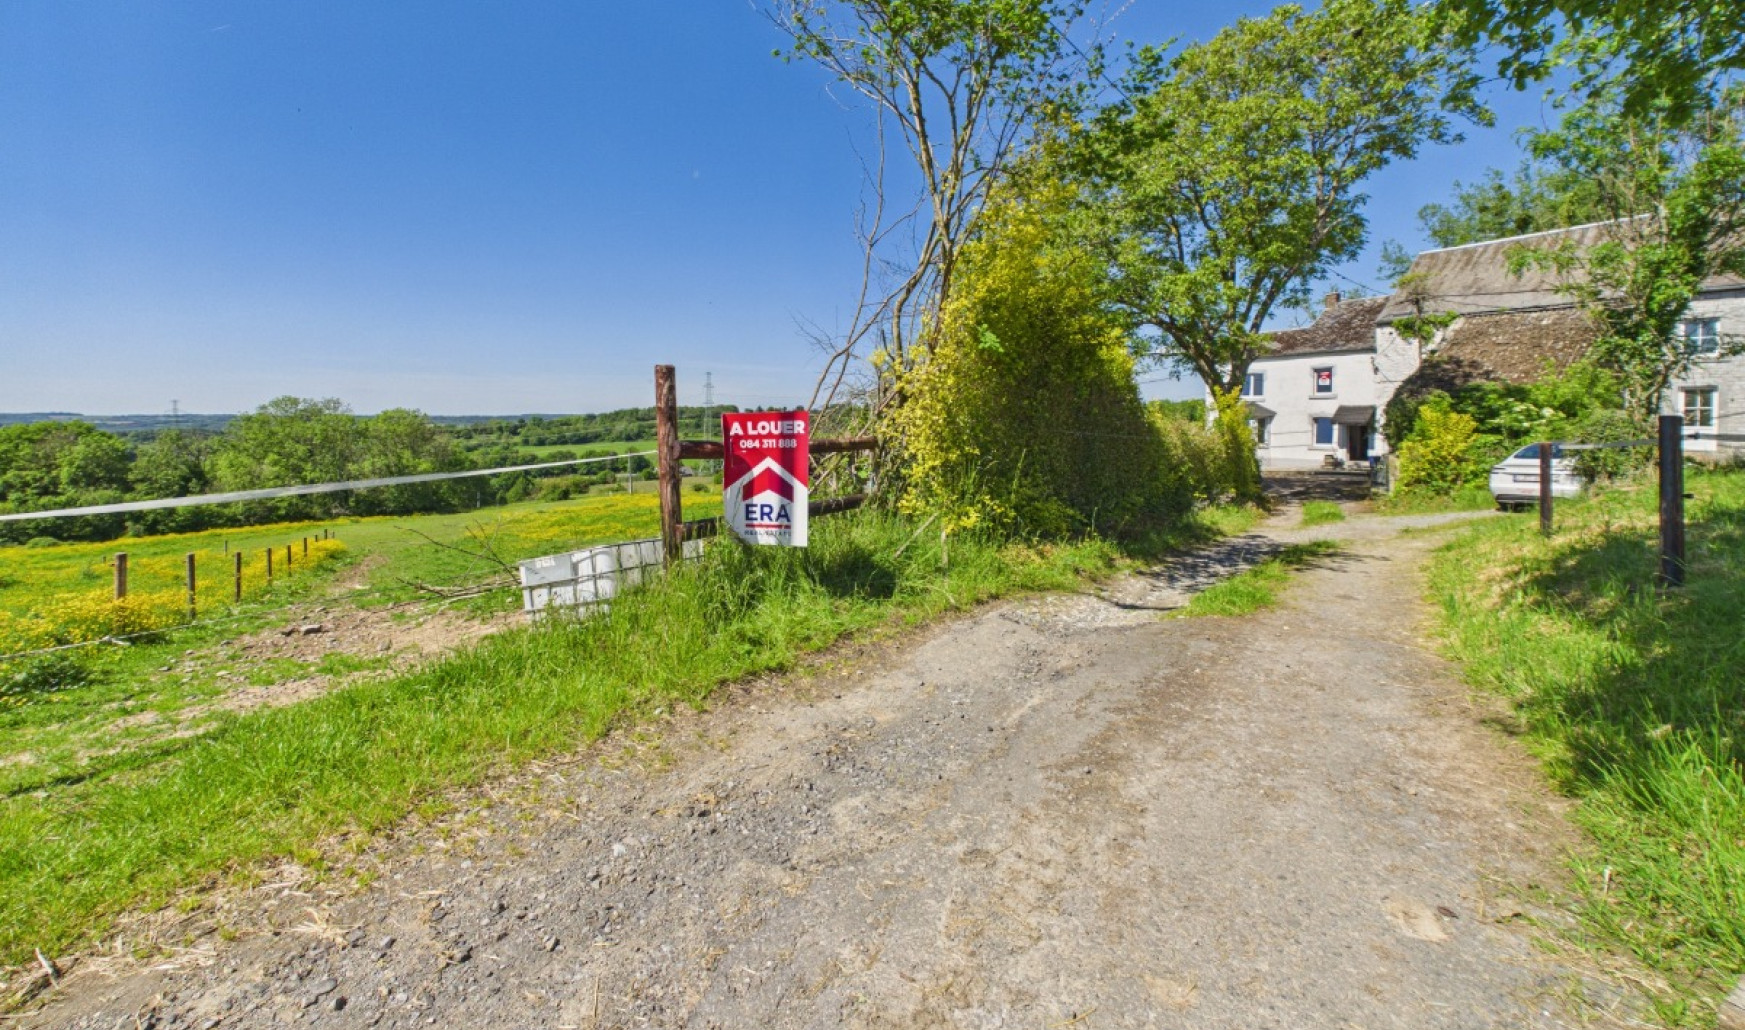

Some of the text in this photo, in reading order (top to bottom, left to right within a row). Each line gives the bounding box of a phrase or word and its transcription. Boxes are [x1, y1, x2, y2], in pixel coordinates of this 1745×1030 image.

[730, 420, 805, 436] A LOUER
[739, 439, 797, 449] 084 311 888
[745, 503, 791, 522] ERA
